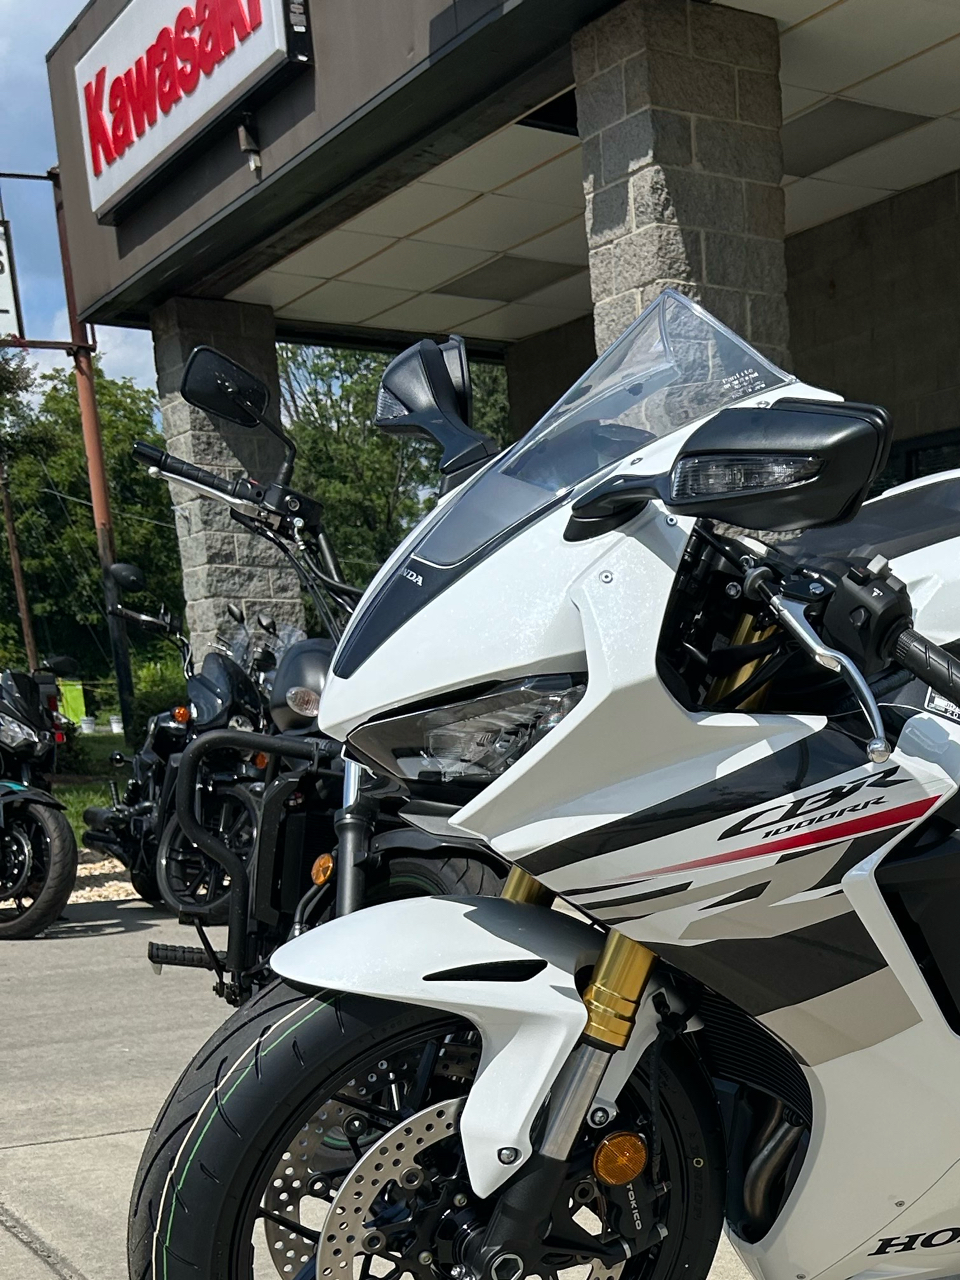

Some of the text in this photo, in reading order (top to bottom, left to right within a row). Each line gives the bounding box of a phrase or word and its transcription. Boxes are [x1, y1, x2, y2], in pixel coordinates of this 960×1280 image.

[403, 569, 423, 587] NDA
[717, 765, 914, 842] CBR
[762, 795, 889, 840] 1000RR
[689, 1144, 704, 1220] DNLOP
[626, 1183, 642, 1230] TOKICO
